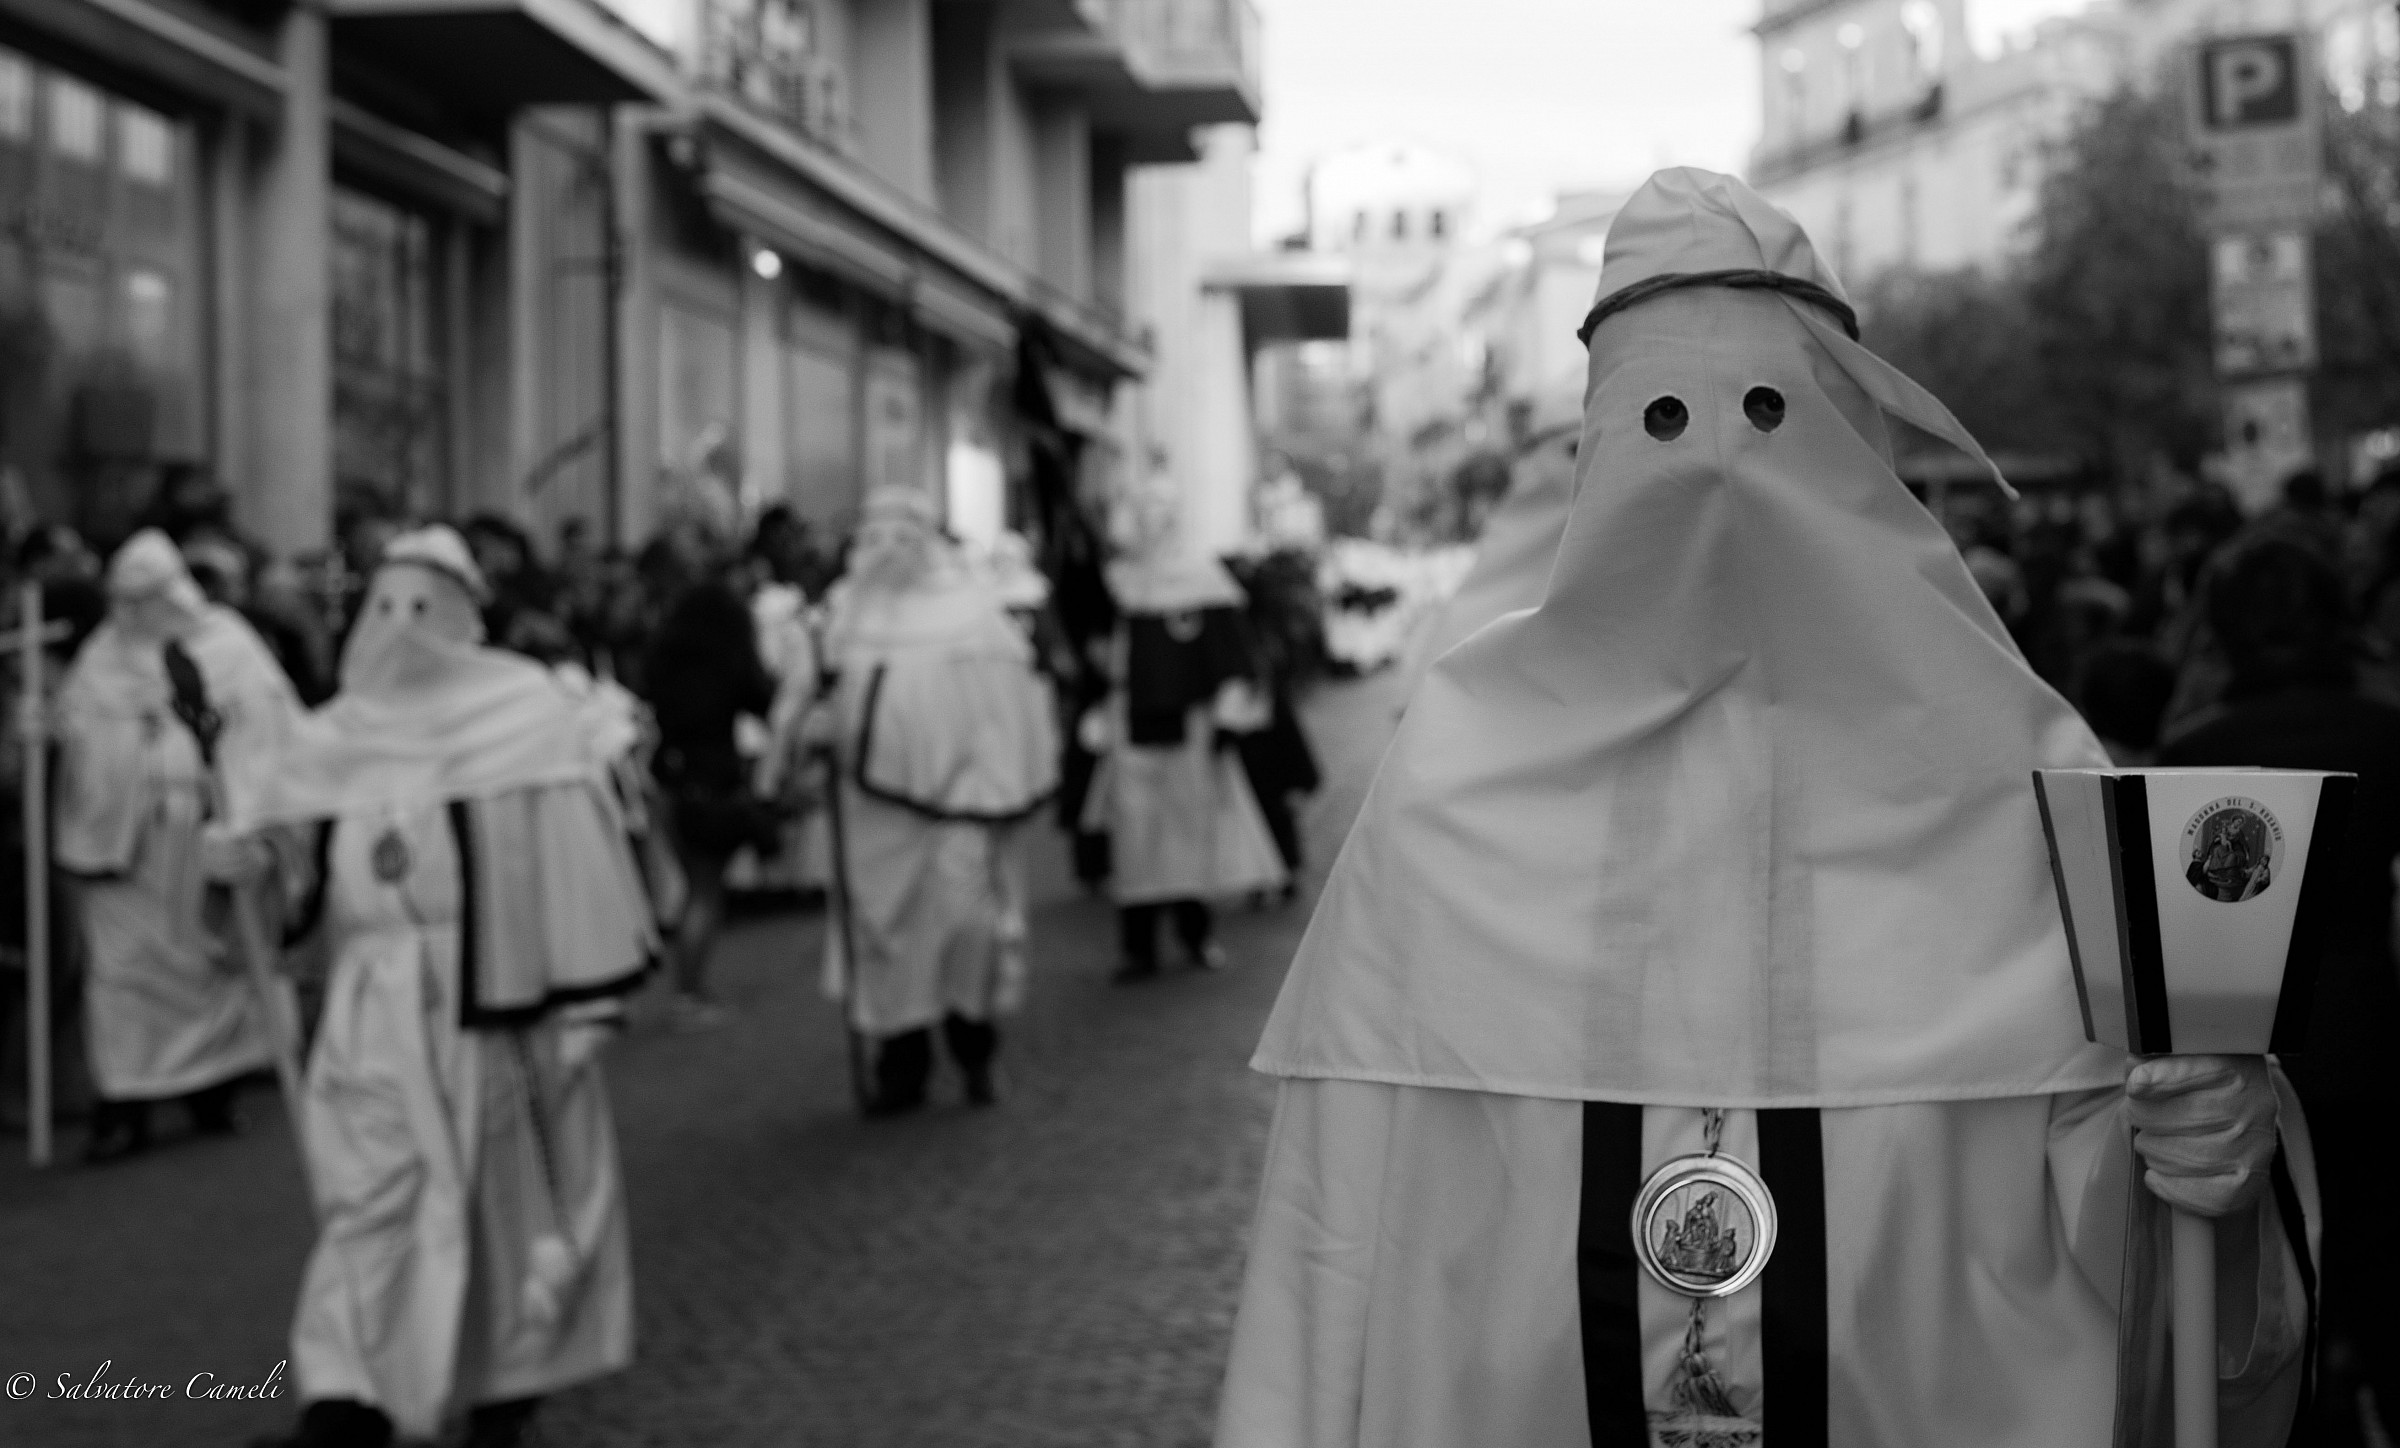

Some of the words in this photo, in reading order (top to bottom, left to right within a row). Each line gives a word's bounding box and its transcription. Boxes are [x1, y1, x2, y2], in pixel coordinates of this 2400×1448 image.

[2215, 48, 2280, 120] P
[2187, 802, 2220, 836] MADONNA
[2259, 808, 2282, 841] ROSARIO
